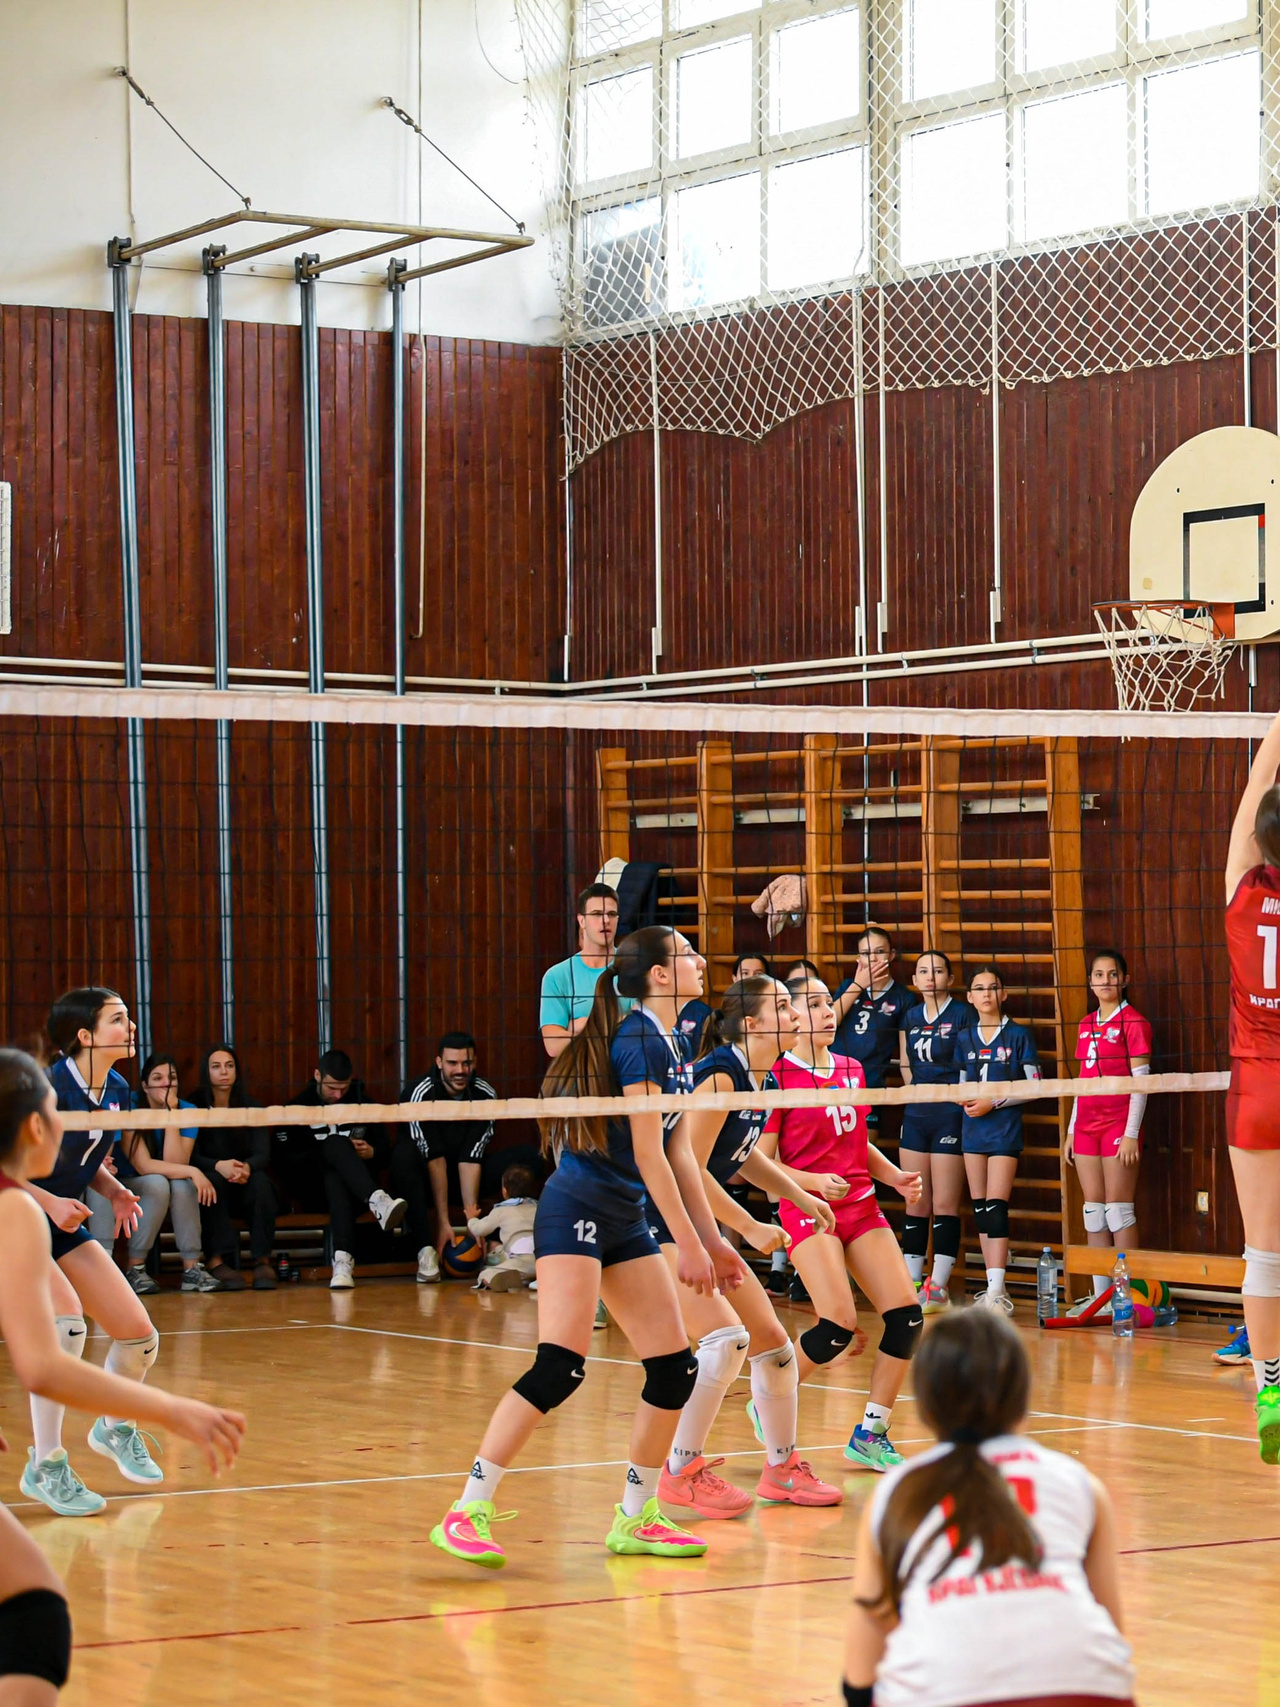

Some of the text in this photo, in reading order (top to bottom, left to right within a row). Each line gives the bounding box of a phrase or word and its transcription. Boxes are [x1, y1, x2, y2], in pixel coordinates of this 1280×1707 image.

[855, 1011, 870, 1034] 3
[914, 1037, 933, 1062] 11
[1085, 1041, 1098, 1069] 5
[825, 1105, 857, 1136] 15
[731, 1126, 760, 1162] 13
[573, 1219, 597, 1244] 12
